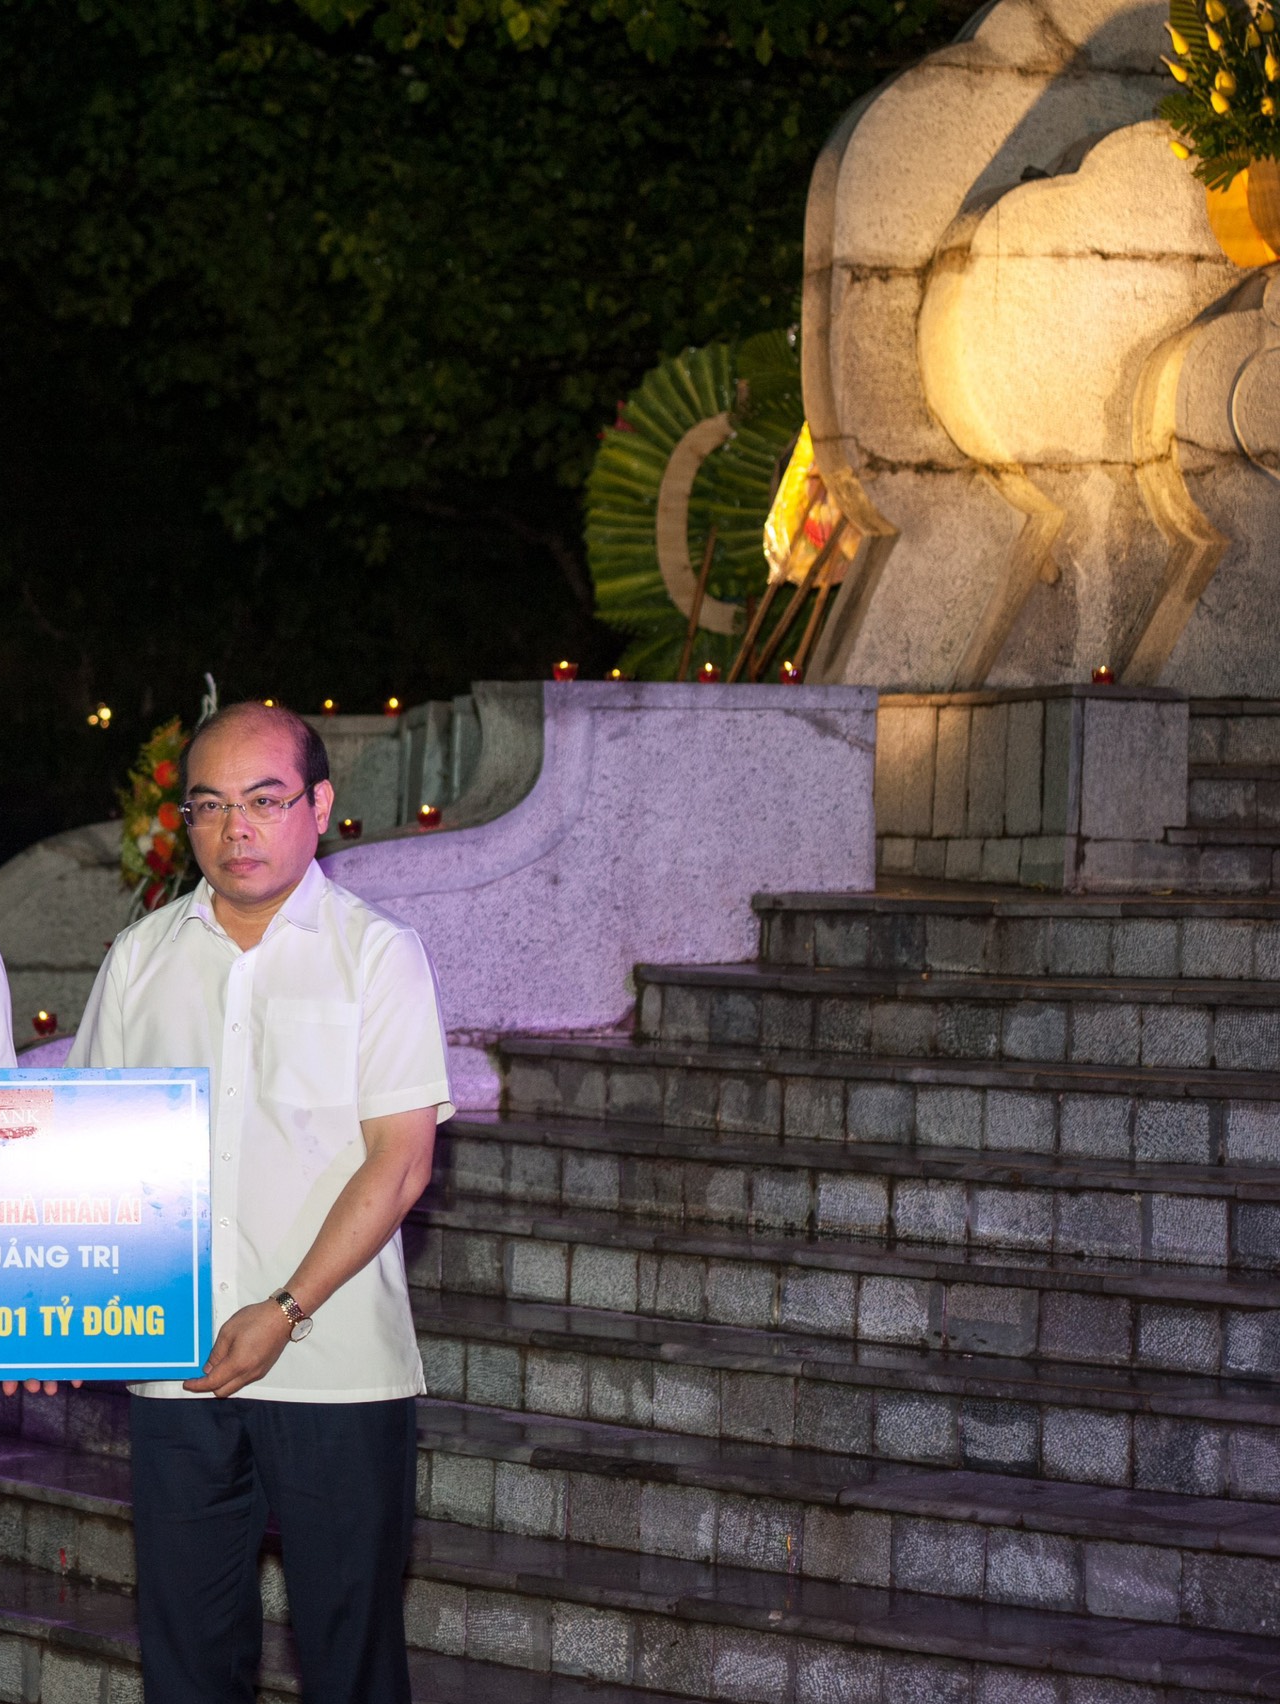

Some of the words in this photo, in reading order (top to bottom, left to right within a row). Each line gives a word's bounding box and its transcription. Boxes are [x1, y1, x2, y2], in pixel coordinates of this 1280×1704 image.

[78, 1245, 119, 1275] TRỊ
[39, 1295, 74, 1336] TỶ
[82, 1295, 165, 1336] ĐỒNG
